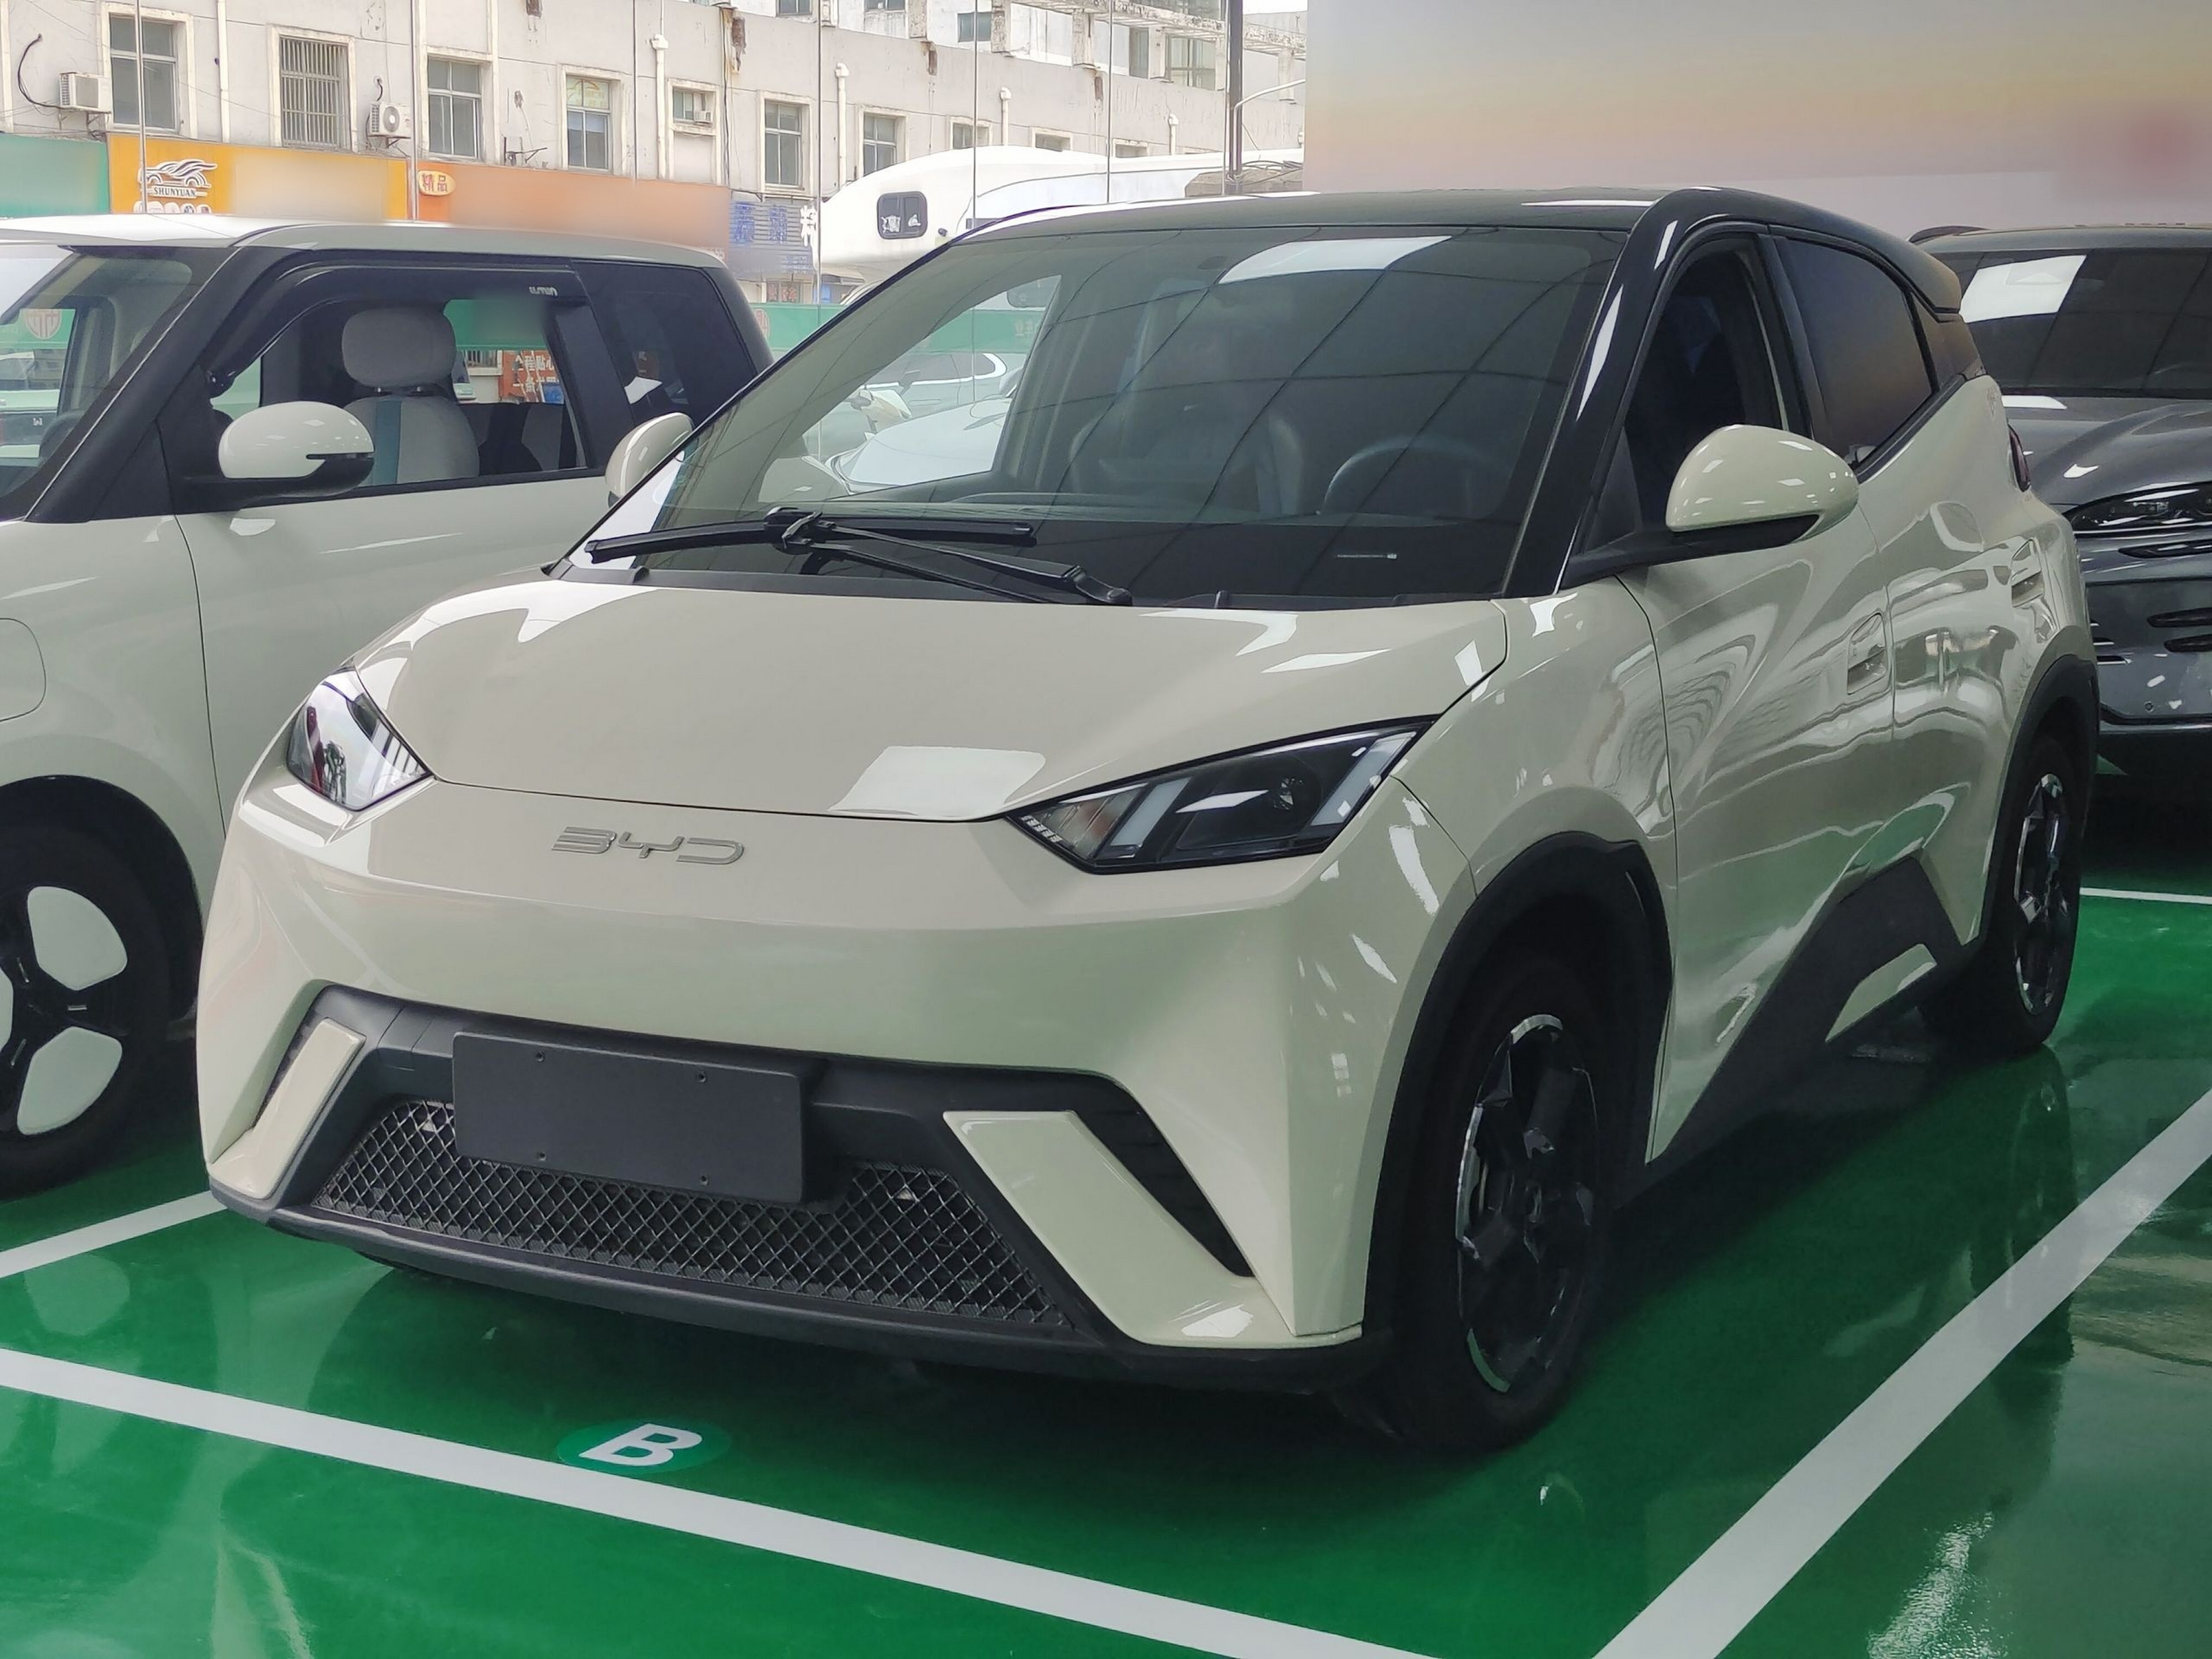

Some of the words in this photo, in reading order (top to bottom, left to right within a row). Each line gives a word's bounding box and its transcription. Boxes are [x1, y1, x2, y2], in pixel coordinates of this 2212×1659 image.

[154, 187, 196, 197] SHUNYUAN
[551, 826, 744, 865] BYD
[578, 1423, 702, 1466] B
